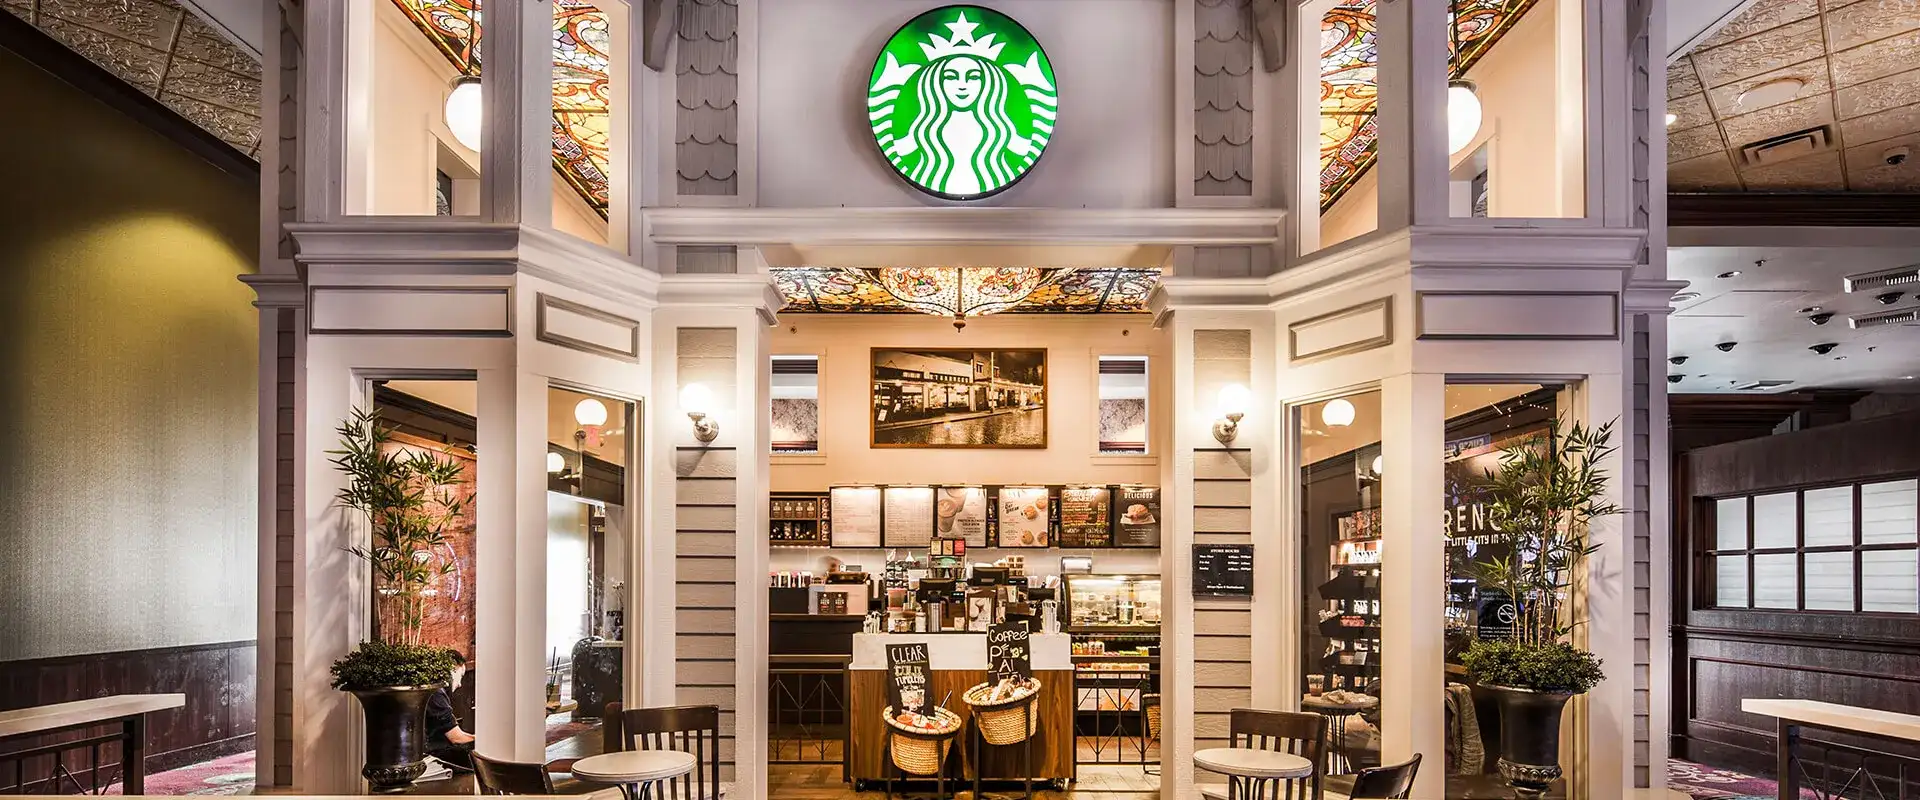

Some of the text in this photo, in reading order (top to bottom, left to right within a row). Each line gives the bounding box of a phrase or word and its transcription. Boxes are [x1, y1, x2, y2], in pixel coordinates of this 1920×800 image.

[1474, 535, 1489, 545] CITY
[989, 629, 1028, 643] Coffee
[891, 645, 926, 663] CLEAR
